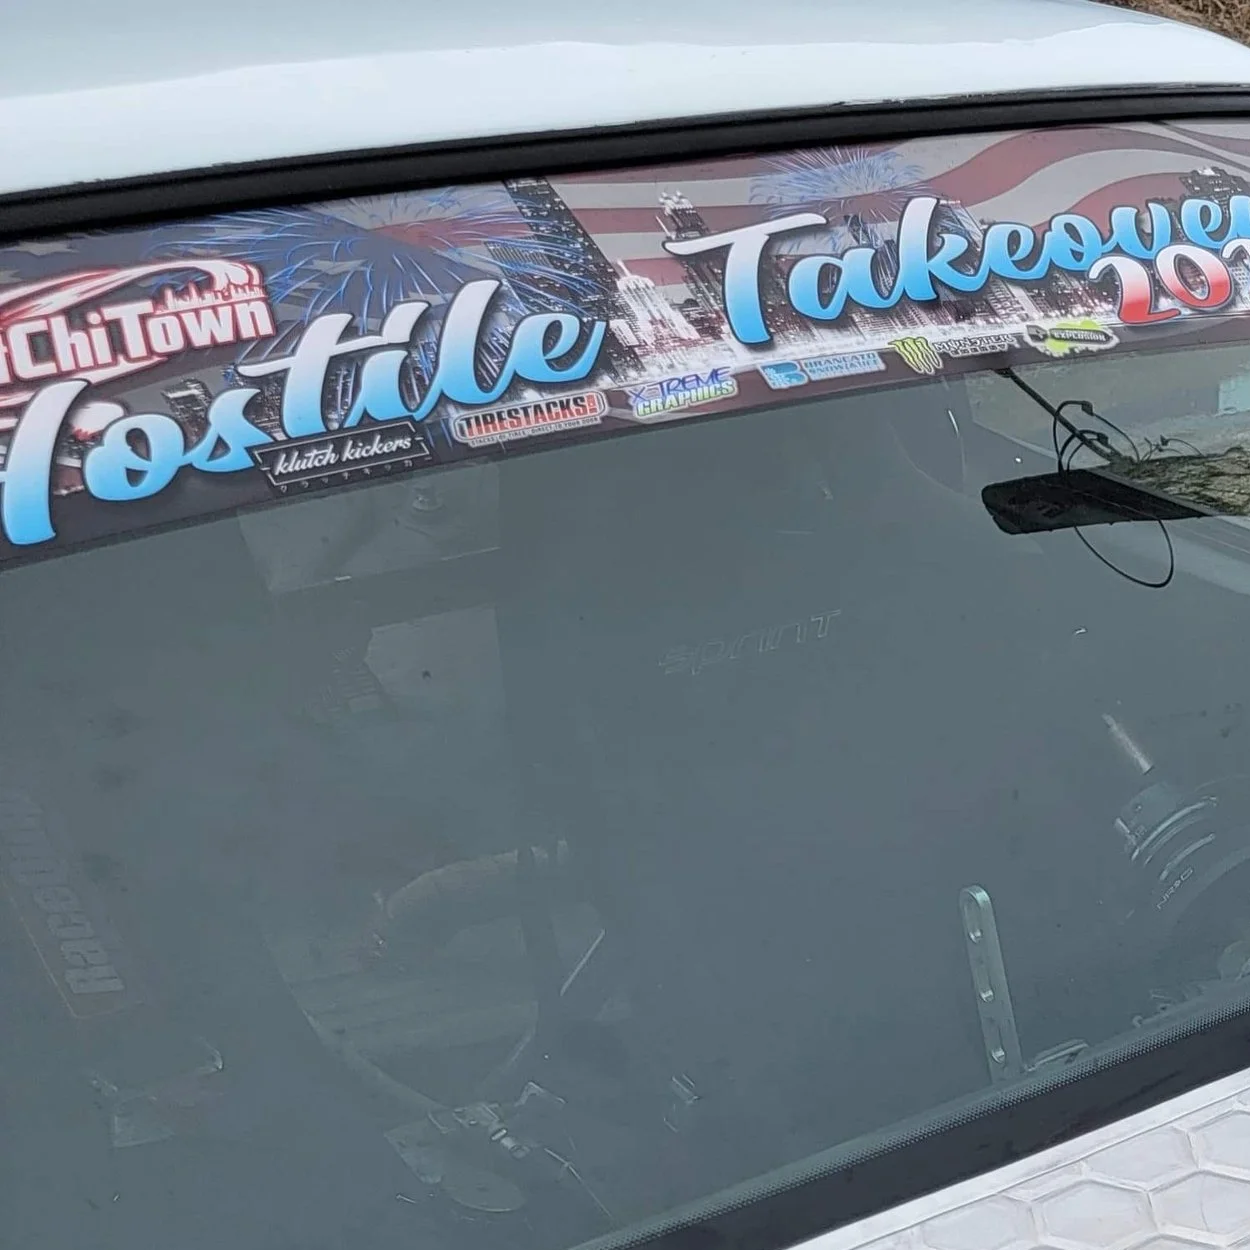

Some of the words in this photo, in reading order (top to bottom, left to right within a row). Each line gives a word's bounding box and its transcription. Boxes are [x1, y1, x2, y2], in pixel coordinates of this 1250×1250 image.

[932, 334, 1014, 351] MONSTER
[463, 396, 587, 438] TIRESTACKS
[636, 380, 736, 417] GRAPHICS
[274, 443, 340, 476] klutch
[342, 433, 412, 462] kickers
